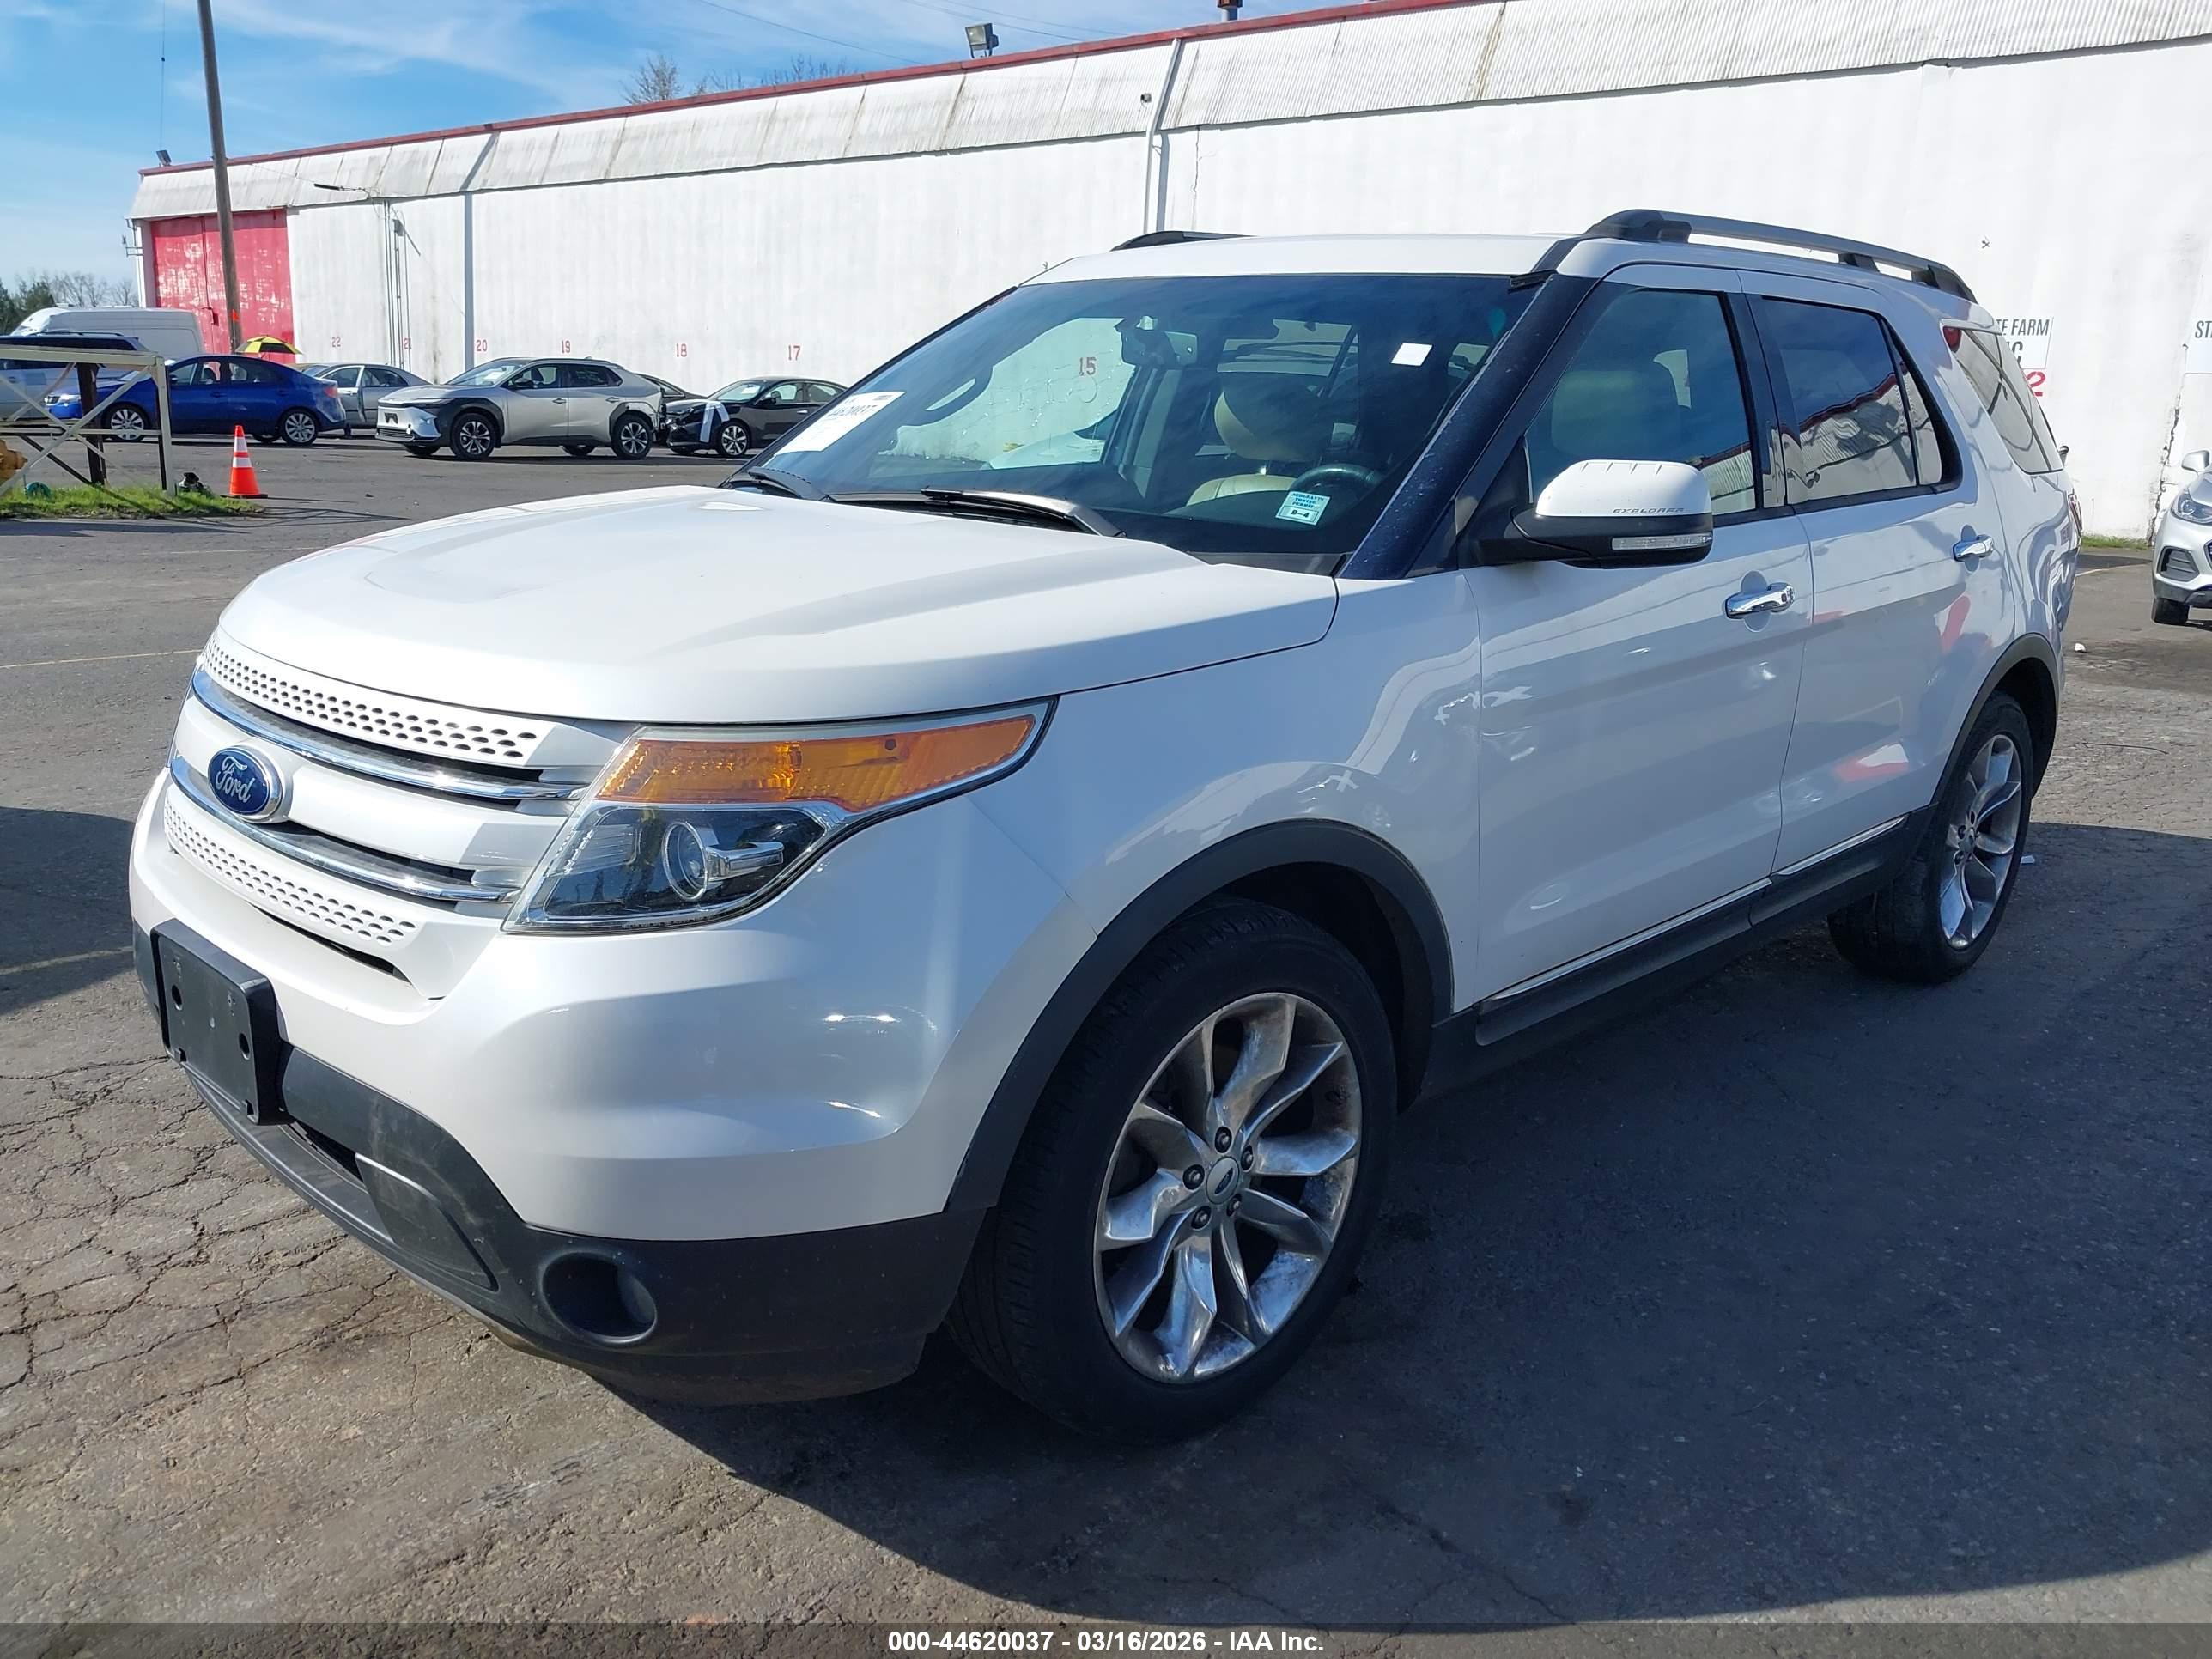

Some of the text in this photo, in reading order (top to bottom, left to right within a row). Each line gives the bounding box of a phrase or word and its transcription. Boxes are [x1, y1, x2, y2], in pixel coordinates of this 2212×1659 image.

[2011, 319, 2050, 336] FARM
[2195, 320, 2212, 338] ST
[331, 336, 342, 347] 22
[476, 339, 488, 352] 20
[561, 340, 571, 354] 19
[676, 343, 688, 357] 18
[788, 345, 801, 361] 17
[1079, 356, 1097, 376] 15
[216, 756, 256, 803] Ford
